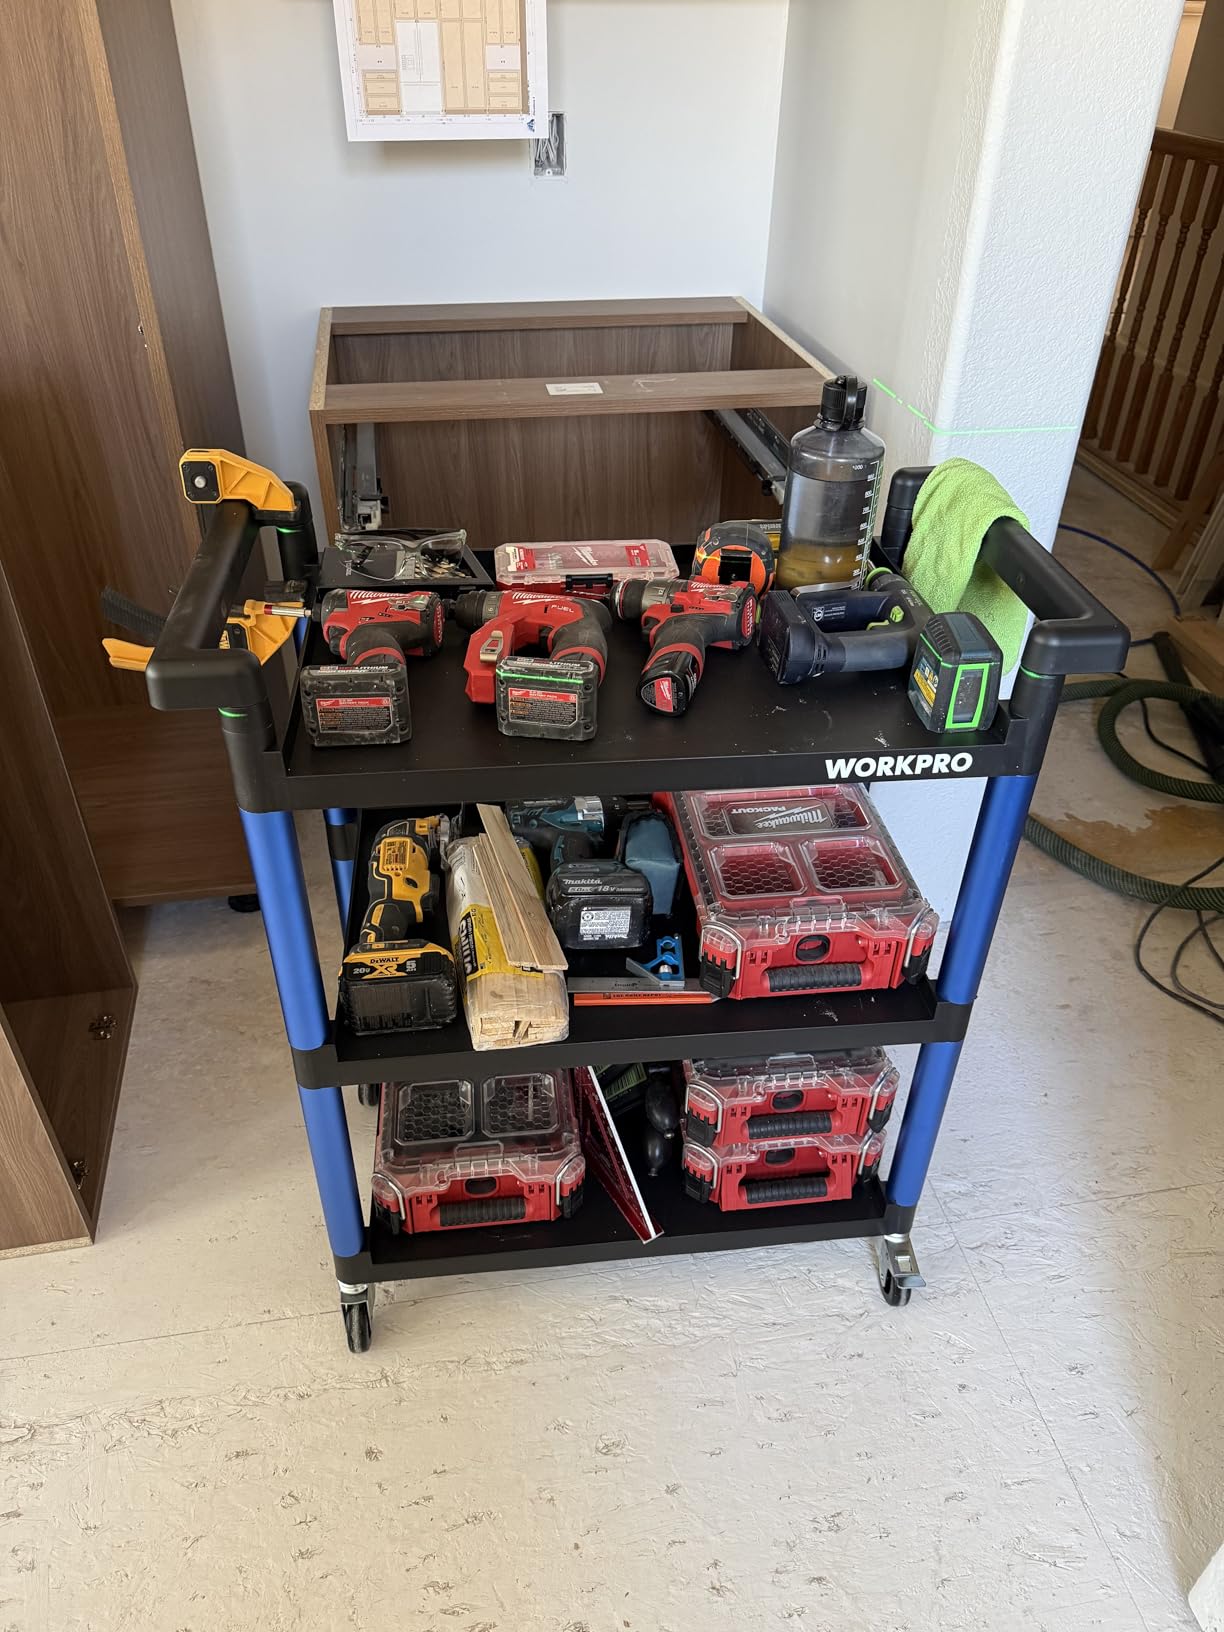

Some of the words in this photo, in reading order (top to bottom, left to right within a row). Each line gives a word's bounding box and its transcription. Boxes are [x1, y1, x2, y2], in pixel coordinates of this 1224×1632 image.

[551, 604, 574, 613] FUEL
[825, 752, 973, 780] WORKPRO
[731, 805, 787, 814] PACKOUT
[754, 809, 828, 829] Milwaukee
[406, 960, 417, 968] 5
